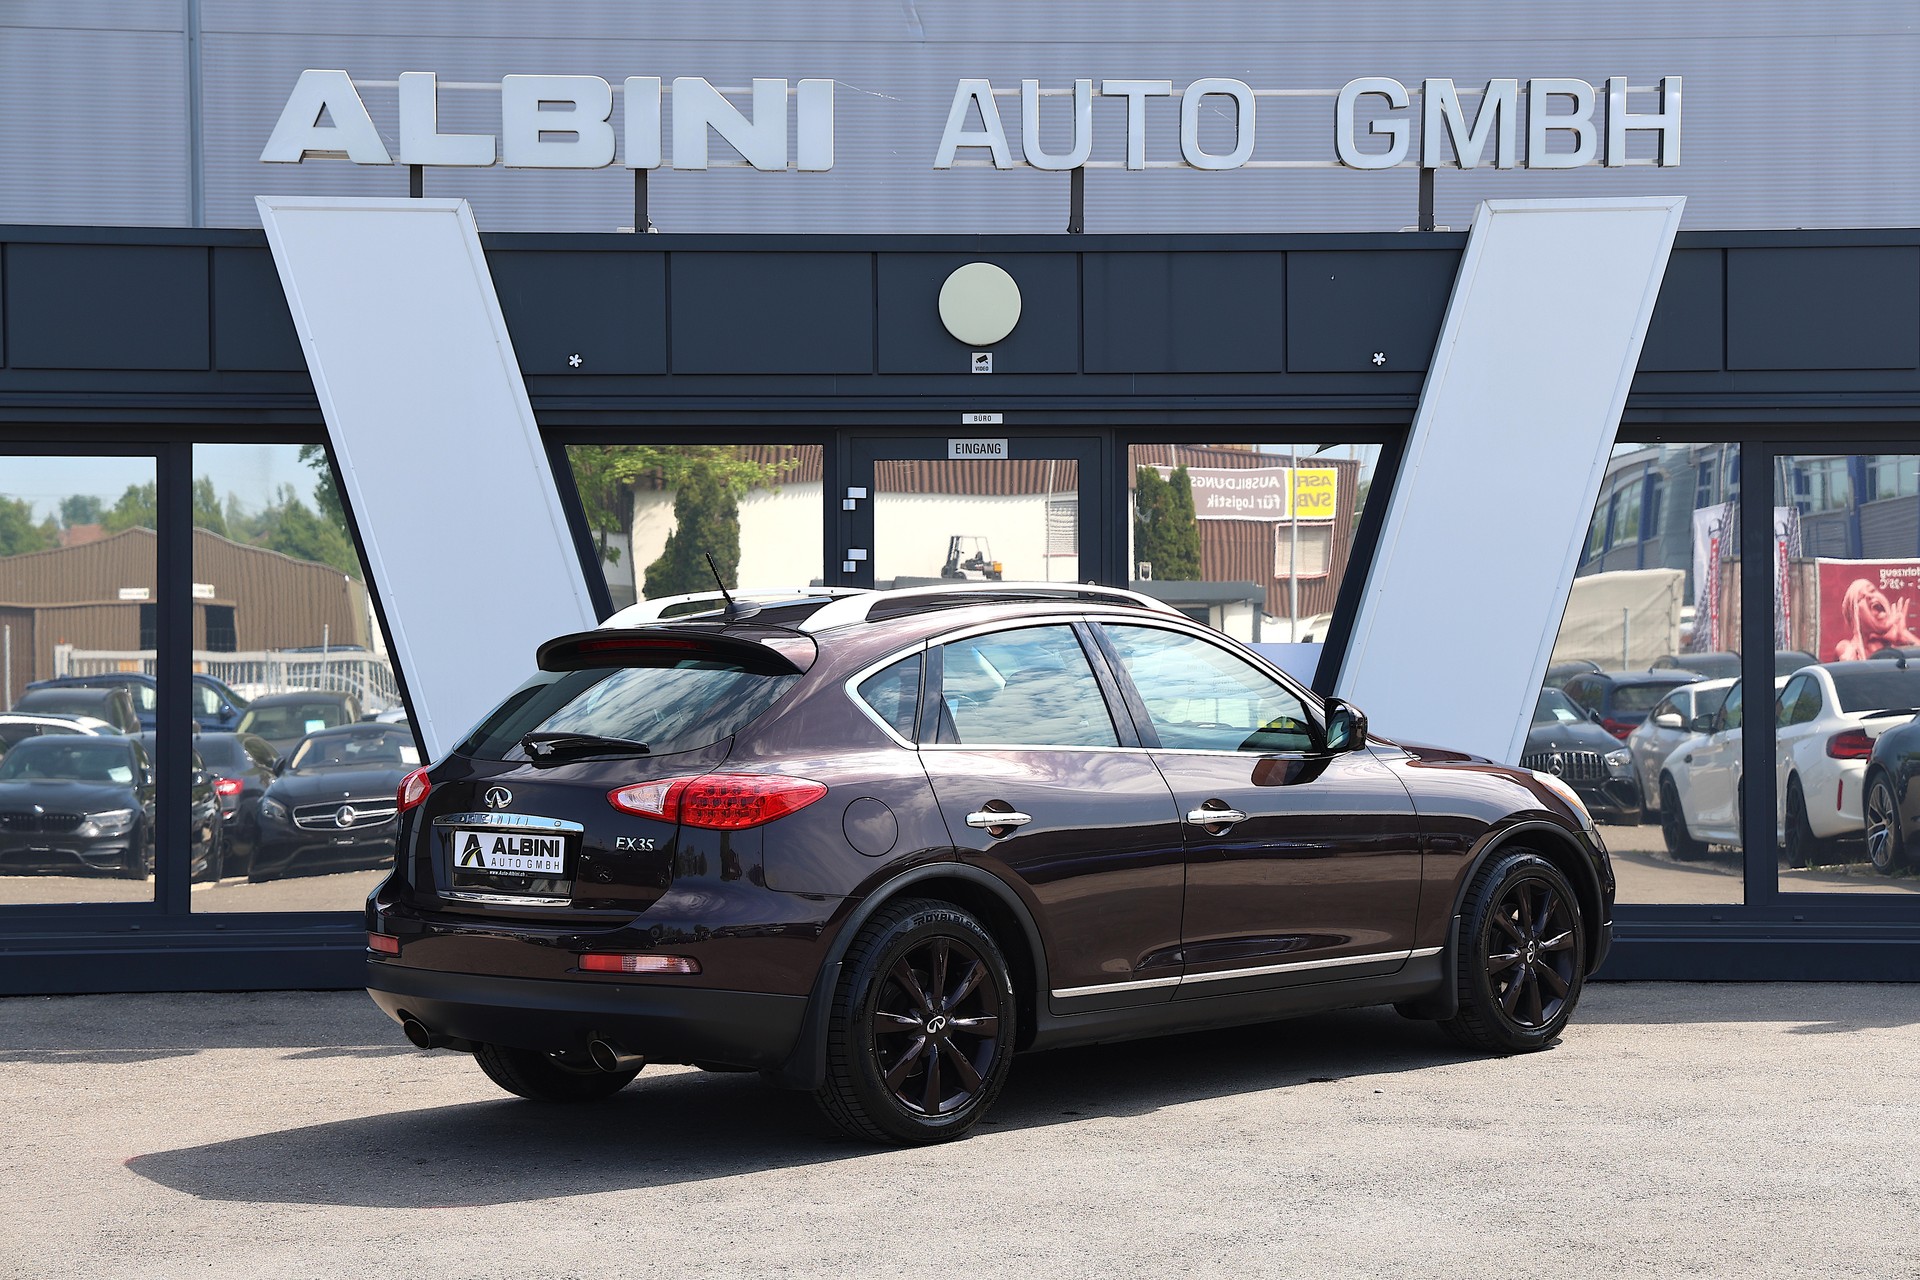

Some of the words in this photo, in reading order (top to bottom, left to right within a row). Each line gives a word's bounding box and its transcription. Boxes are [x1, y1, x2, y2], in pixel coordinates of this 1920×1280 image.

[259, 69, 835, 172] ALBINI
[932, 76, 1257, 171] AUTO
[1334, 75, 1683, 171] GMBH
[973, 414, 992, 422] BÜRO
[955, 443, 1001, 454] EINGANG
[491, 836, 560, 858] ALBINI
[616, 836, 655, 852] EX35
[490, 857, 522, 868] AUTO
[526, 859, 561, 871] GMBH
